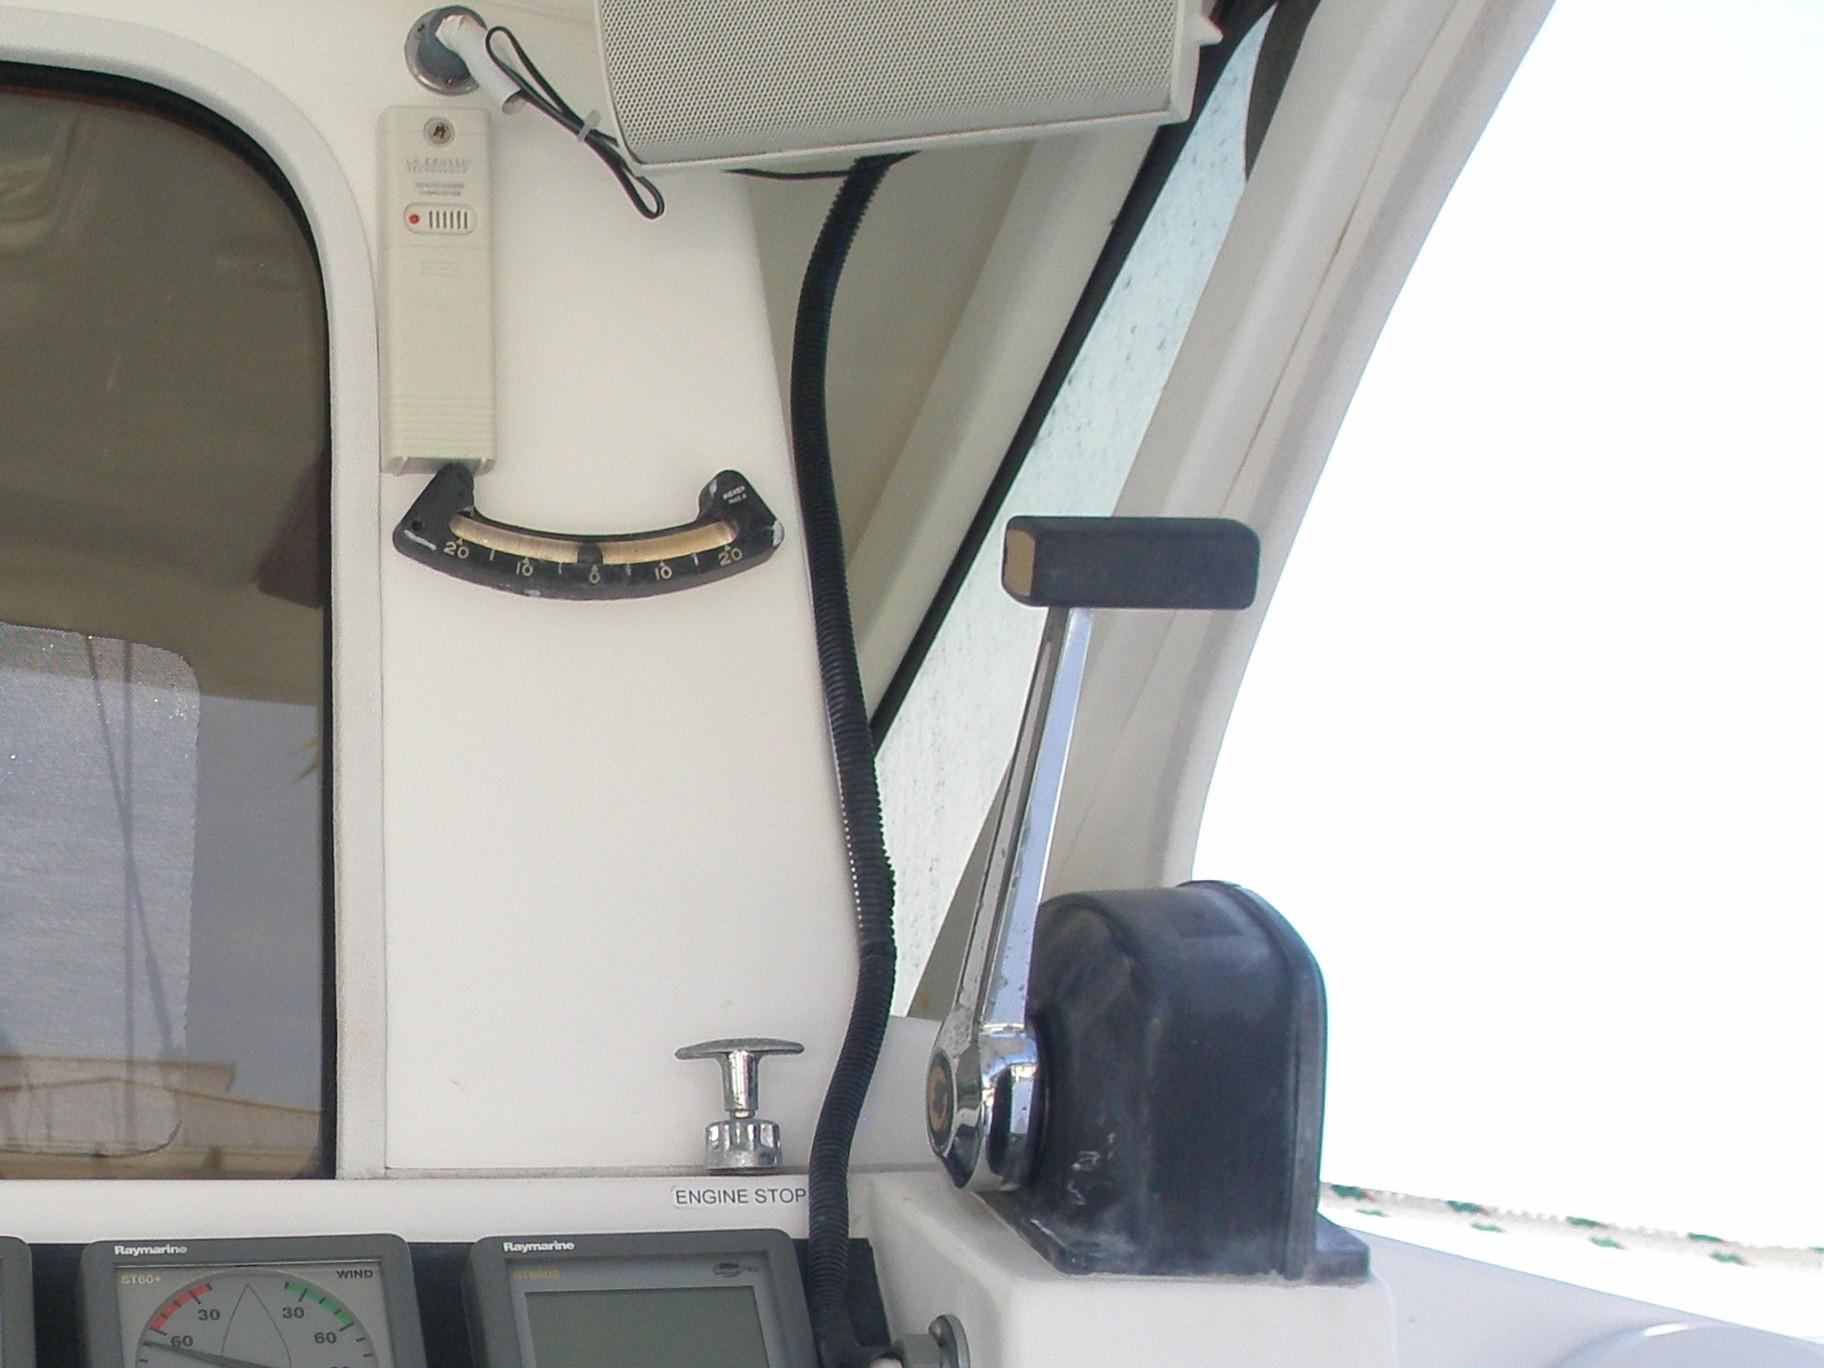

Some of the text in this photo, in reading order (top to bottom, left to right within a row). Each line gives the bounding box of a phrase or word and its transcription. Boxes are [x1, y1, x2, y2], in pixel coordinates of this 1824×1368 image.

[443, 542, 469, 560] 20
[517, 562, 533, 577] 10
[655, 565, 672, 580] 10
[719, 548, 743, 565] 20
[676, 1187, 807, 1205] ENGINE STOP
[114, 1245, 188, 1257] Raymarine
[503, 1241, 576, 1253] Raymarine
[120, 1274, 161, 1285] ST60+
[337, 1269, 374, 1280] WIND
[197, 1308, 221, 1321] 30
[282, 1307, 305, 1319] 30
[170, 1335, 194, 1347] 60
[314, 1332, 337, 1344] 60
